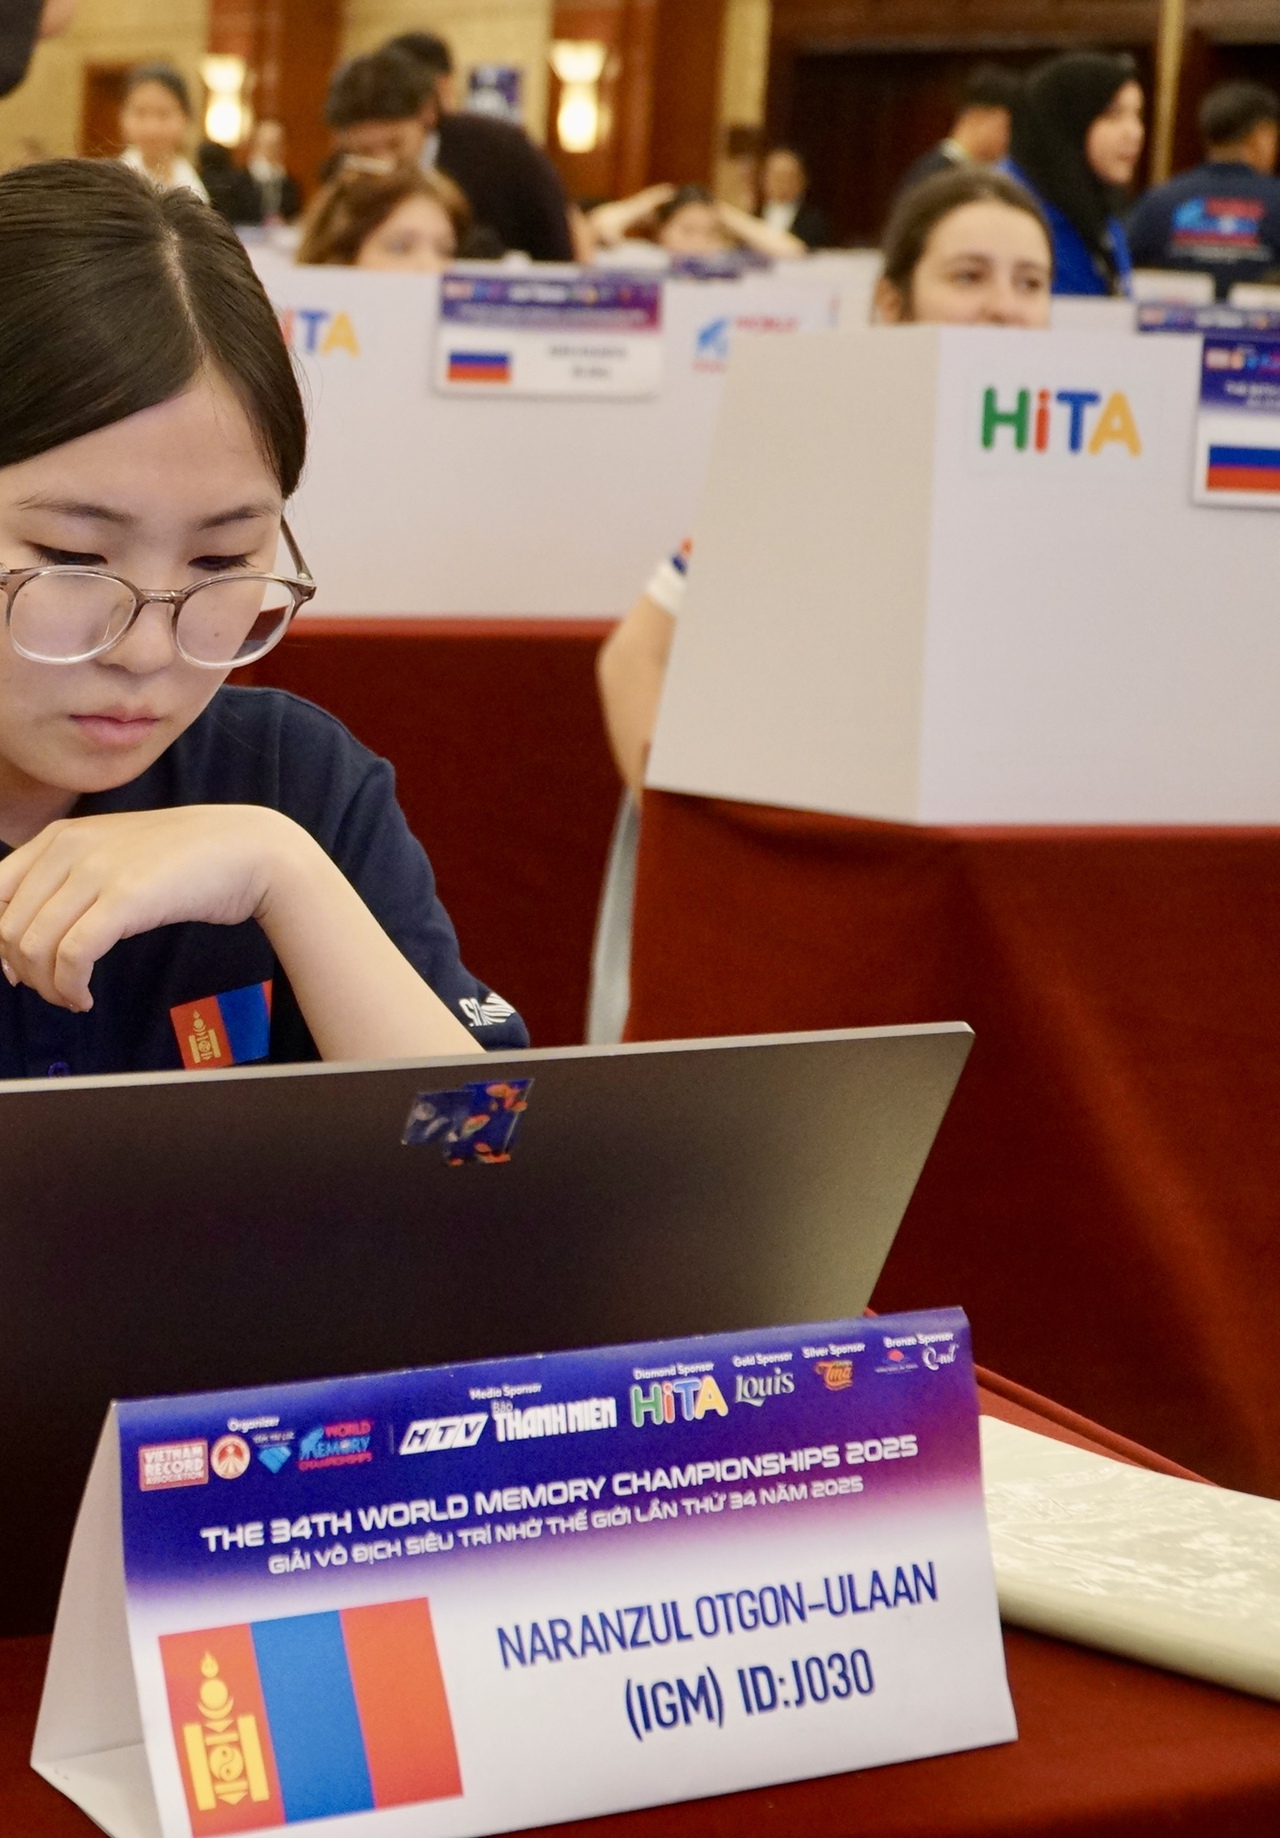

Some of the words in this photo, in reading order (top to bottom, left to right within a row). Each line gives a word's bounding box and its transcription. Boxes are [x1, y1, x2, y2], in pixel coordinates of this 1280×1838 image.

[280, 308, 361, 357] iTA
[981, 386, 1143, 457] HiTA
[801, 1345, 829, 1359] Silver
[829, 1342, 866, 1357] Sponsor
[882, 1336, 918, 1349] Bronze
[916, 1332, 954, 1346] Sponsor
[633, 1364, 677, 1380] Diamond
[677, 1361, 715, 1377] Sponsor
[732, 1353, 755, 1368] Gold
[756, 1351, 793, 1367] Sponsor
[470, 1387, 502, 1401] Media
[503, 1382, 543, 1399] Sponsor
[630, 1374, 729, 1428] HiTA
[735, 1367, 795, 1407] Louis
[227, 1415, 281, 1433] Organizer
[402, 1416, 486, 1453] HTV
[144, 1445, 204, 1464] VIETNAM
[144, 1457, 204, 1475] RECORD
[200, 1521, 265, 1553] THE
[270, 1510, 353, 1545] 34TH
[358, 1493, 469, 1532] WORLD
[474, 1475, 607, 1515] MEMORY
[612, 1444, 840, 1498] CHAMPIONSHIPS
[845, 1433, 920, 1465] 2025
[730, 1492, 758, 1511] 34
[812, 1474, 865, 1497] 2025
[496, 1601, 693, 1670] NARANZUL
[694, 1560, 939, 1638] OTGON-ULAAN
[624, 1666, 725, 1742] (IGM)
[737, 1648, 876, 1716] ID:J030
